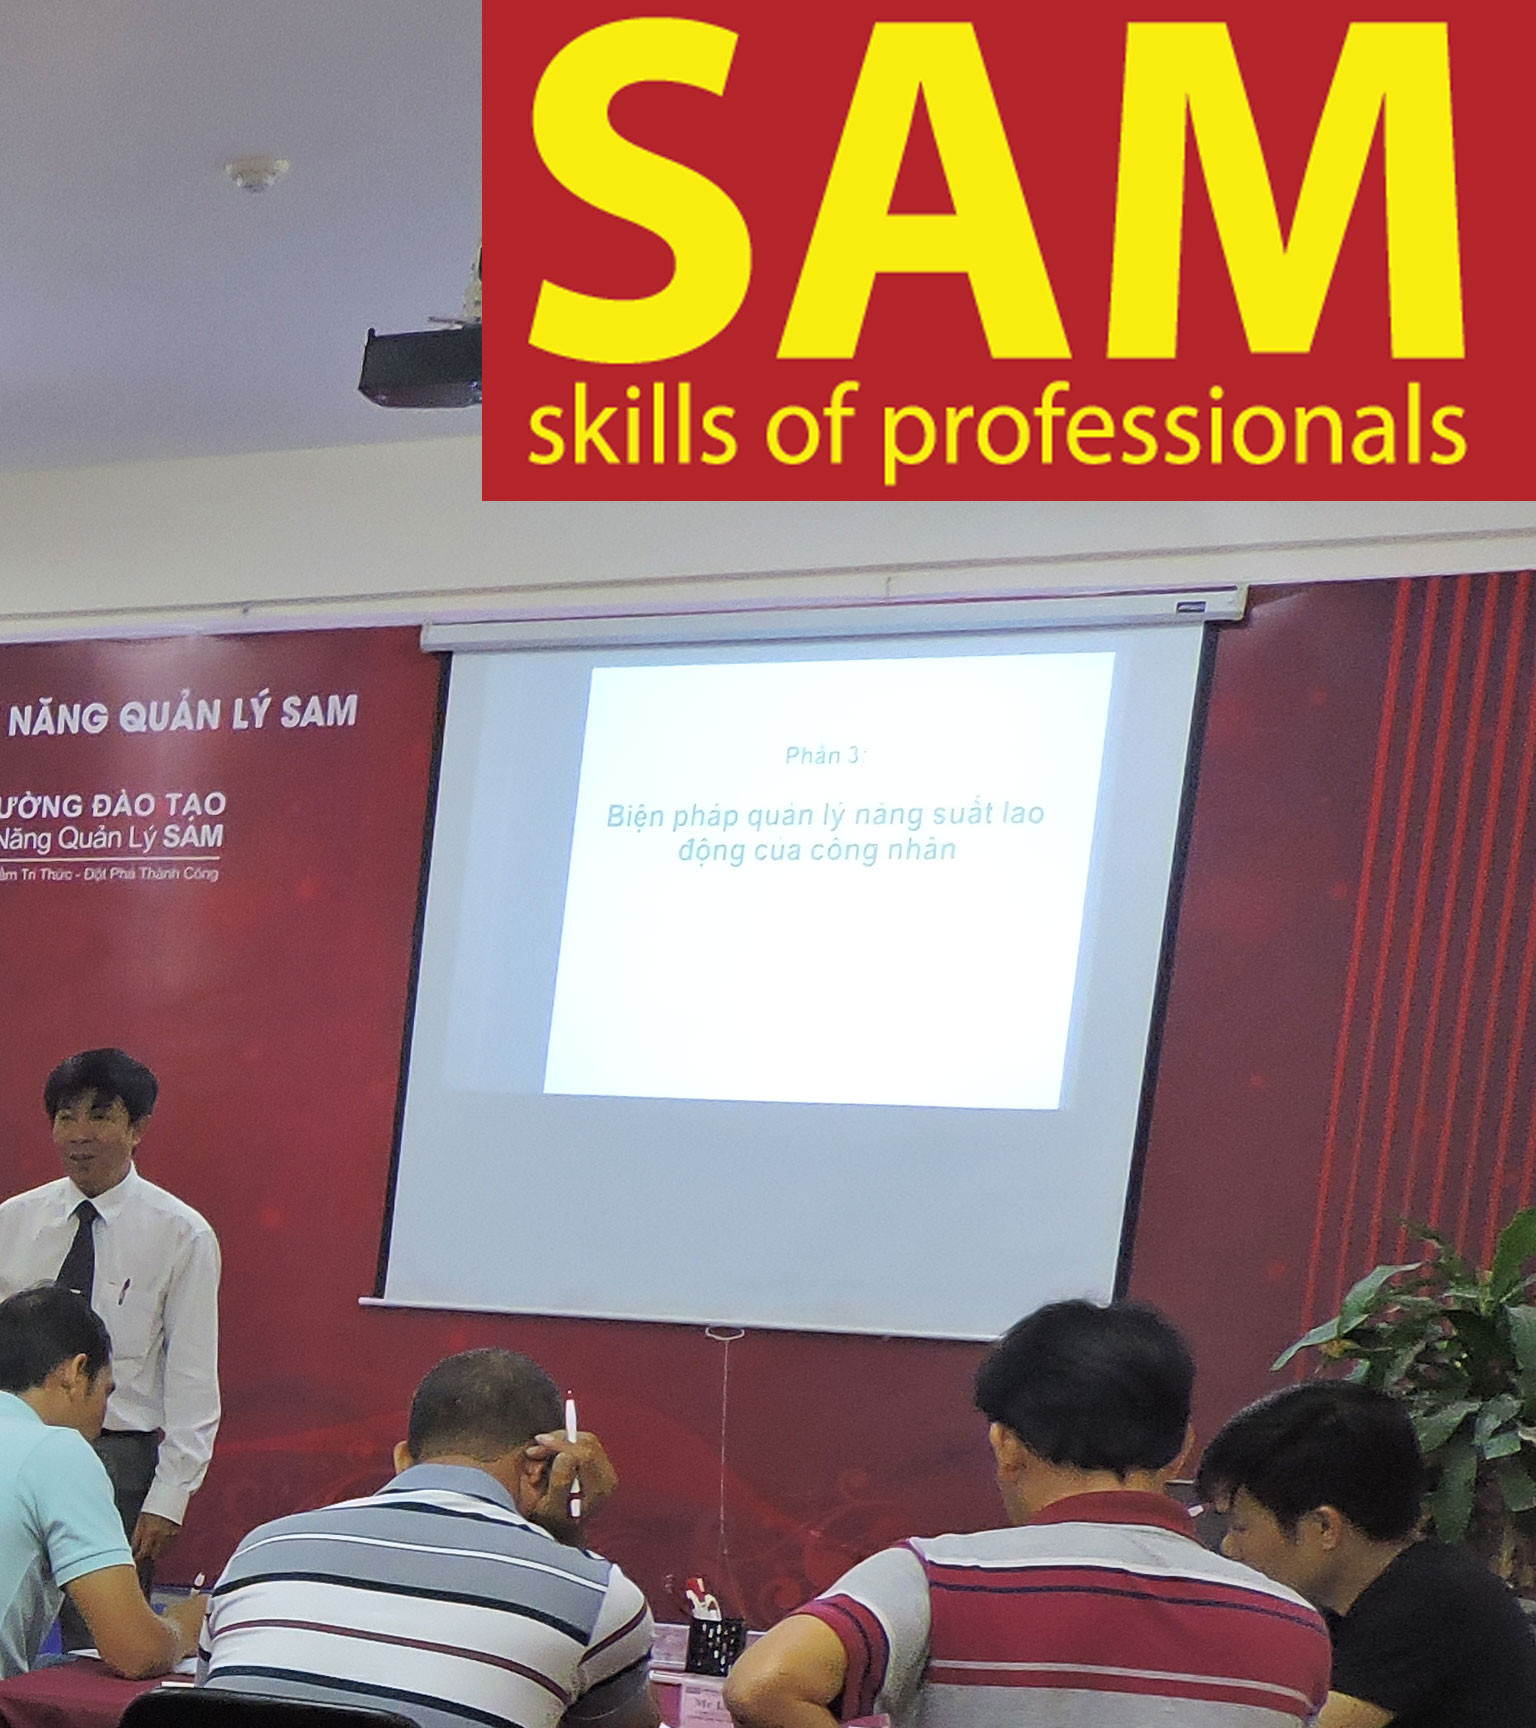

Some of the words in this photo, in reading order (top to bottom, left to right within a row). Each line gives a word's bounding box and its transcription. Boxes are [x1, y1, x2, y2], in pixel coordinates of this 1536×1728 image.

[8, 697, 109, 736] NĂNG
[119, 688, 221, 733] QUẢN
[233, 688, 271, 729] LÝ
[280, 694, 358, 729] SAM
[91, 789, 156, 817] ĐÀO
[165, 792, 226, 822] TẠO
[607, 803, 664, 832] Biện
[673, 803, 739, 832] pháp
[747, 802, 813, 831] quản
[823, 802, 846, 831] lý
[855, 801, 923, 831] năng
[933, 795, 994, 825] suất
[1002, 800, 1045, 825] lao
[58, 824, 122, 851] Quản
[129, 824, 158, 853] Lý
[163, 824, 224, 848] SAM
[678, 837, 746, 867] động
[754, 836, 801, 861] của
[811, 837, 879, 867] công
[888, 836, 956, 861] nhân
